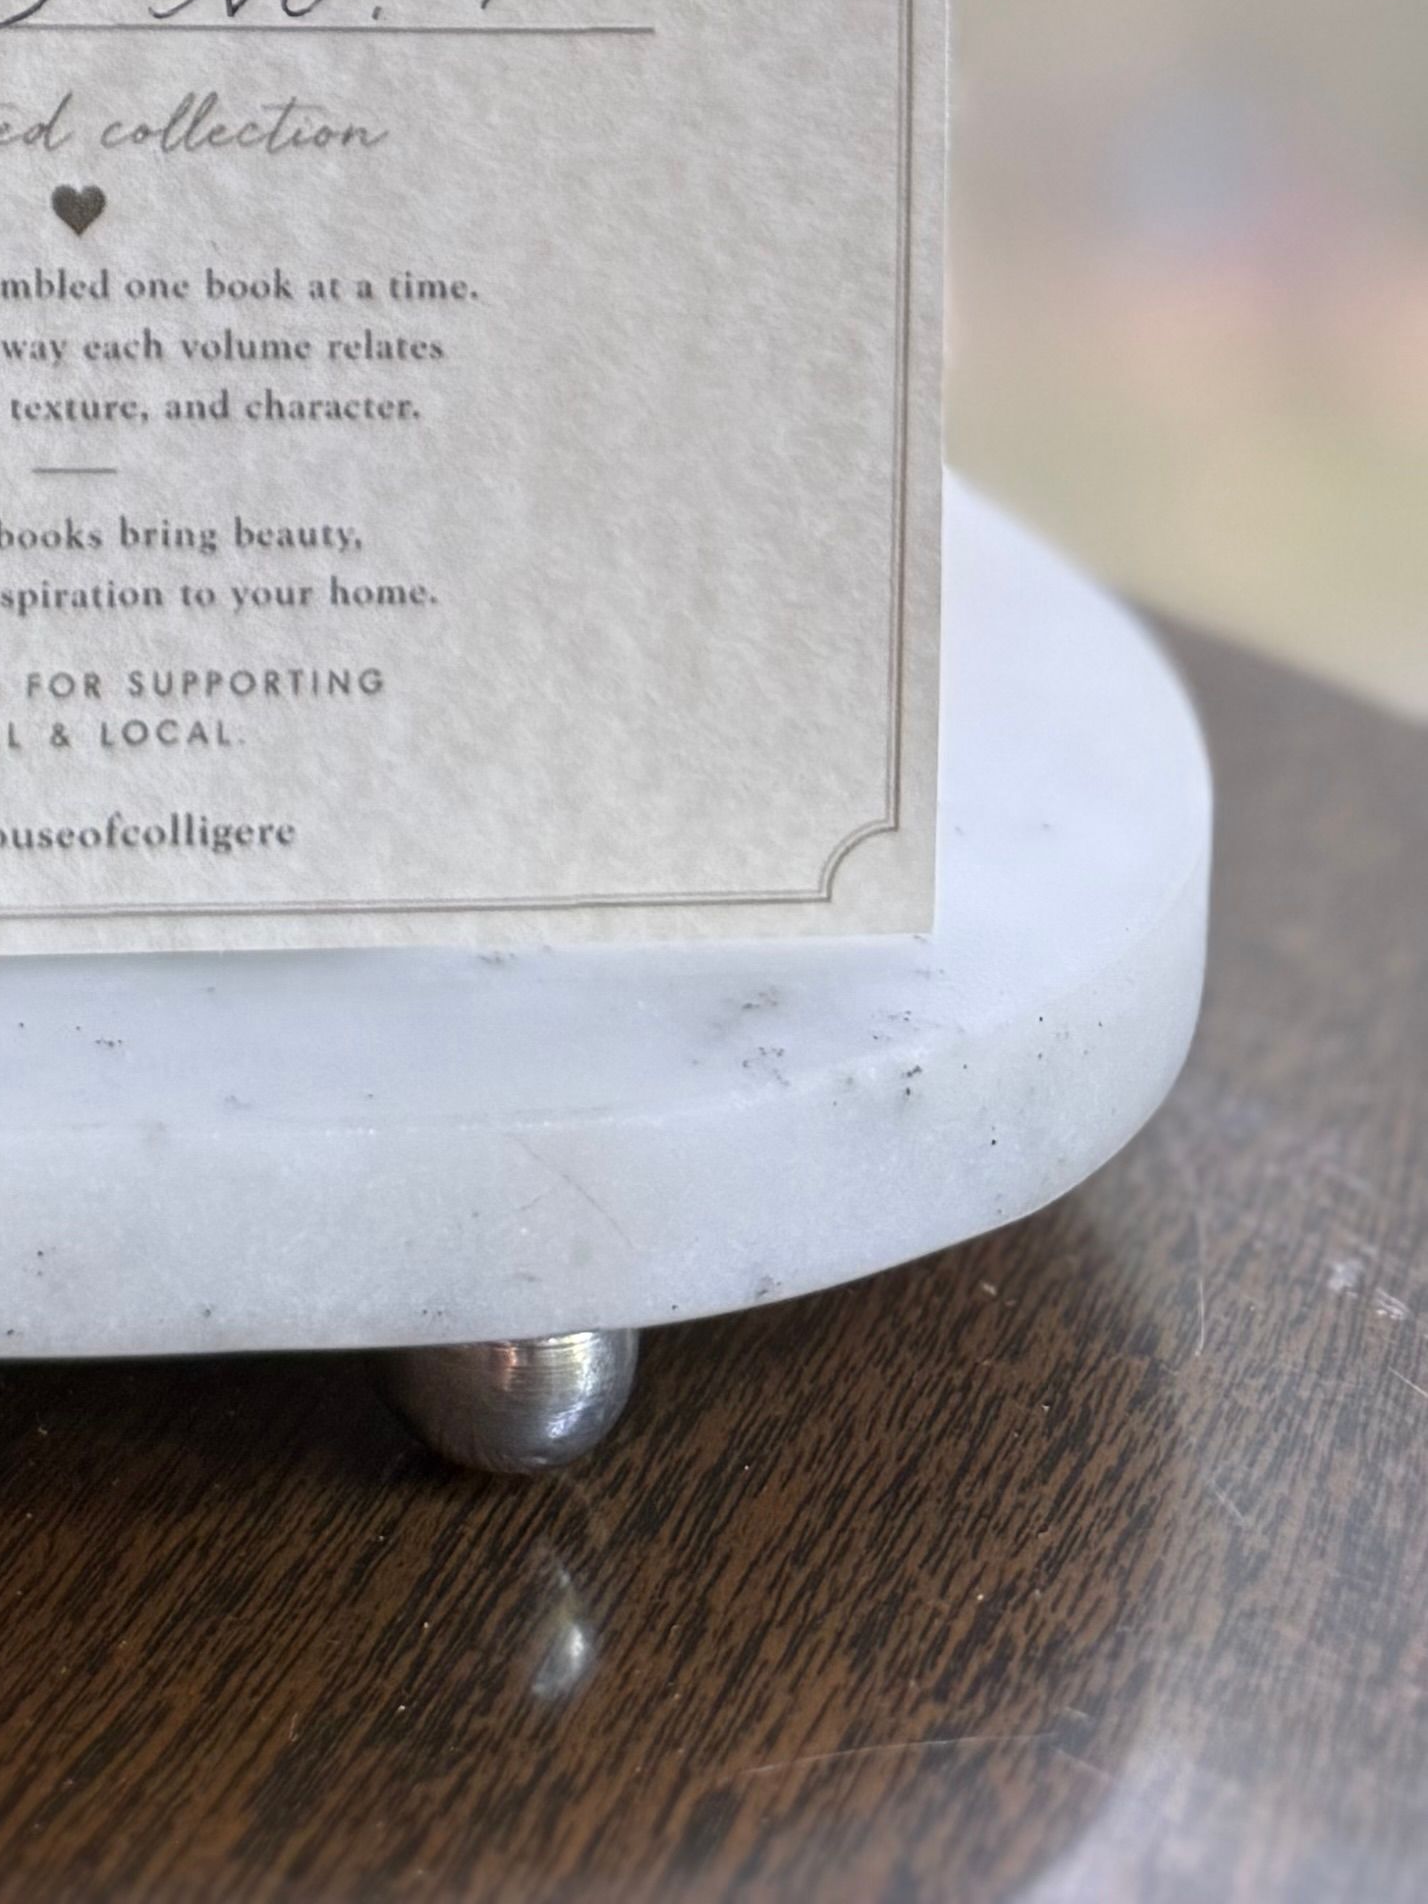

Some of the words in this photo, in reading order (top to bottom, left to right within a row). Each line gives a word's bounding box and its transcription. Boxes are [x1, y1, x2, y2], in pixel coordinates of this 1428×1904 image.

[101, 92, 388, 155] collection
[125, 279, 189, 299] one
[207, 268, 292, 299] book
[309, 279, 339, 300] at
[357, 281, 374, 300] a
[390, 272, 477, 300] time.
[2, 338, 68, 368] way
[84, 328, 164, 361] each
[182, 329, 310, 360] volume
[329, 329, 444, 360] relates
[10, 398, 149, 424] texture,
[166, 389, 230, 421] and
[245, 389, 419, 420] character.
[120, 516, 217, 555] bring
[235, 516, 362, 552] beauty,
[181, 586, 216, 607] to
[232, 586, 314, 615] your
[331, 576, 436, 606] home.
[27, 673, 100, 699] FOR
[129, 669, 383, 698] SUPPORTING
[50, 723, 70, 748] &
